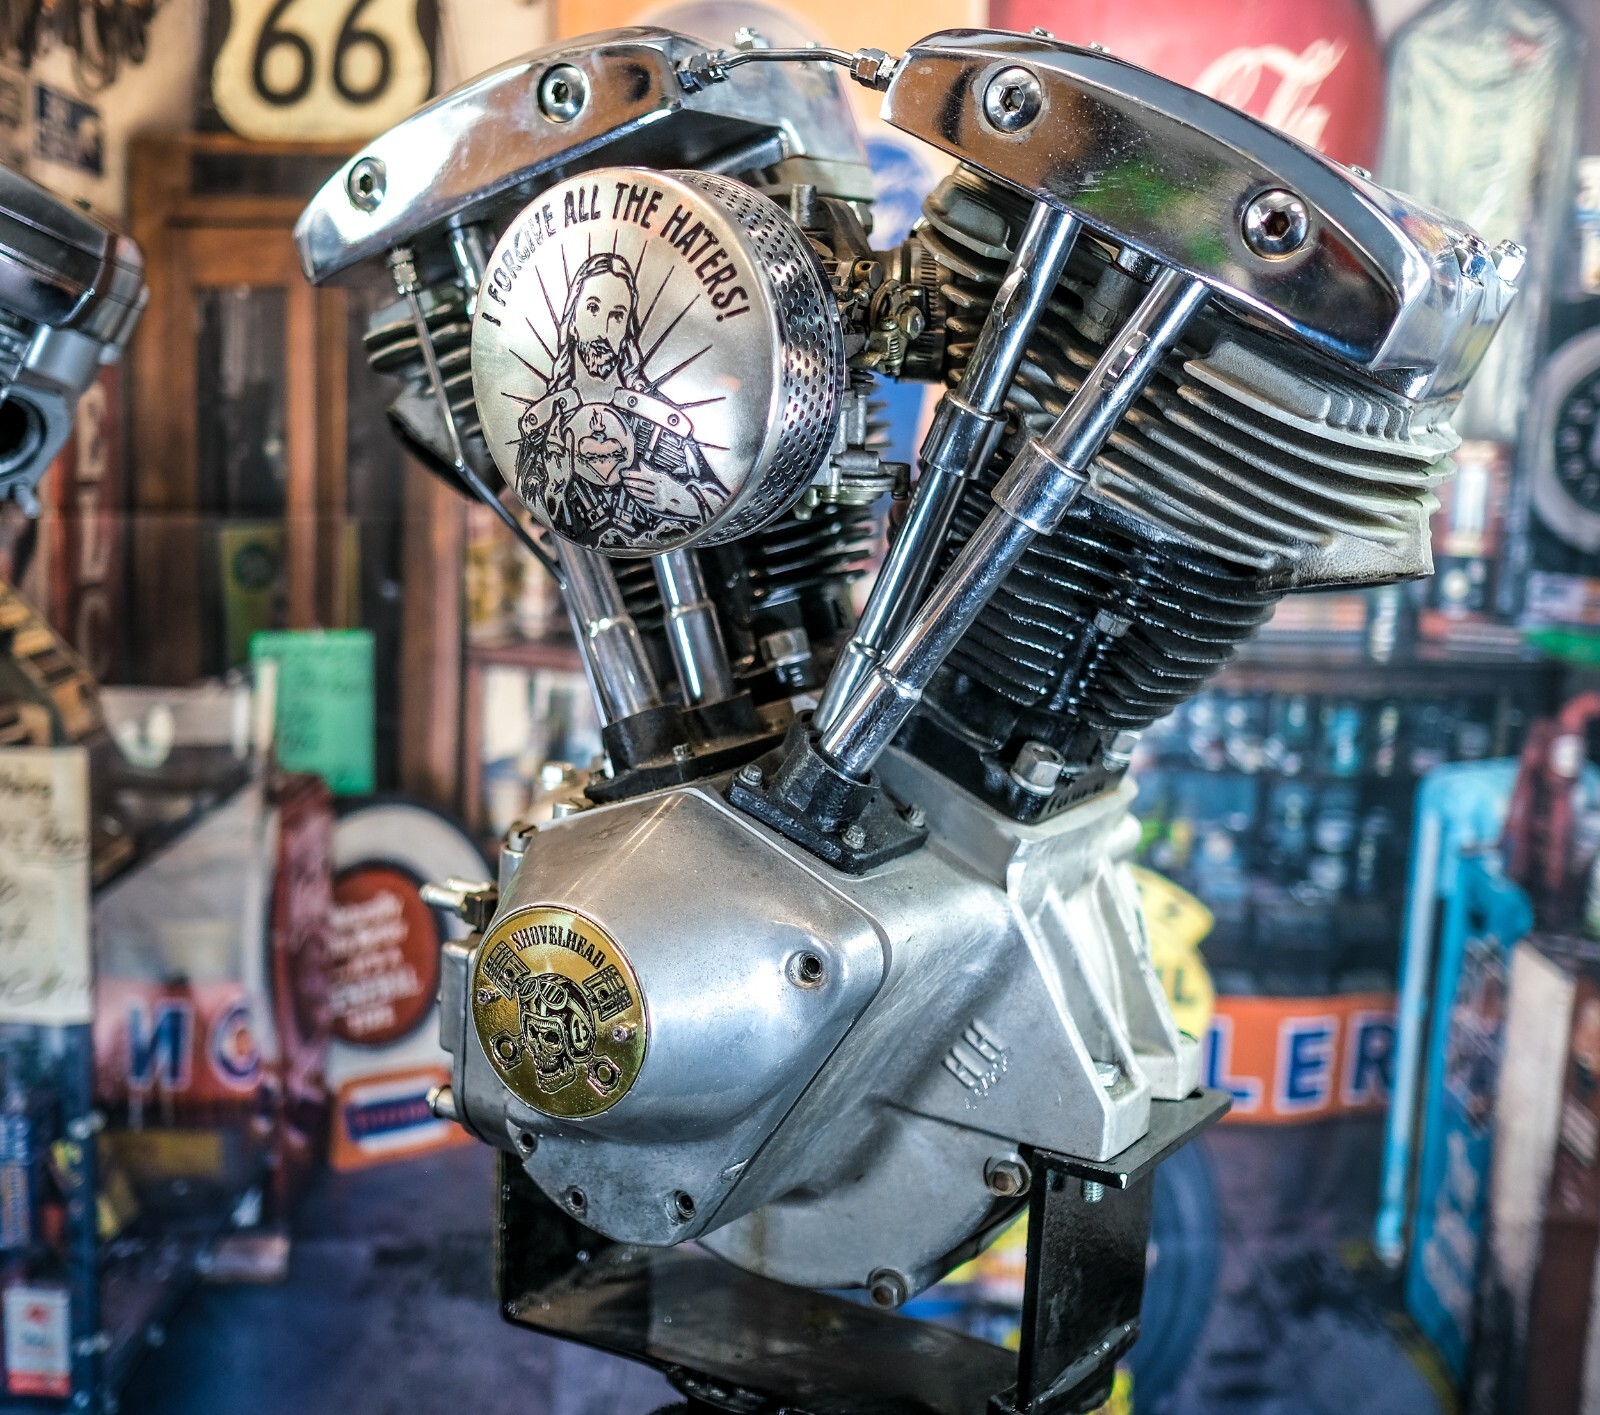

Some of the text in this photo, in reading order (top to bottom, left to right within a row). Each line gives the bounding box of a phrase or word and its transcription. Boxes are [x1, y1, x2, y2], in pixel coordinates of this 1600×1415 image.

[253, 0, 396, 106] 66
[481, 182, 751, 328] I FORGIVE ALL THE HATERS!
[510, 925, 606, 970] SHOVELHEAD
